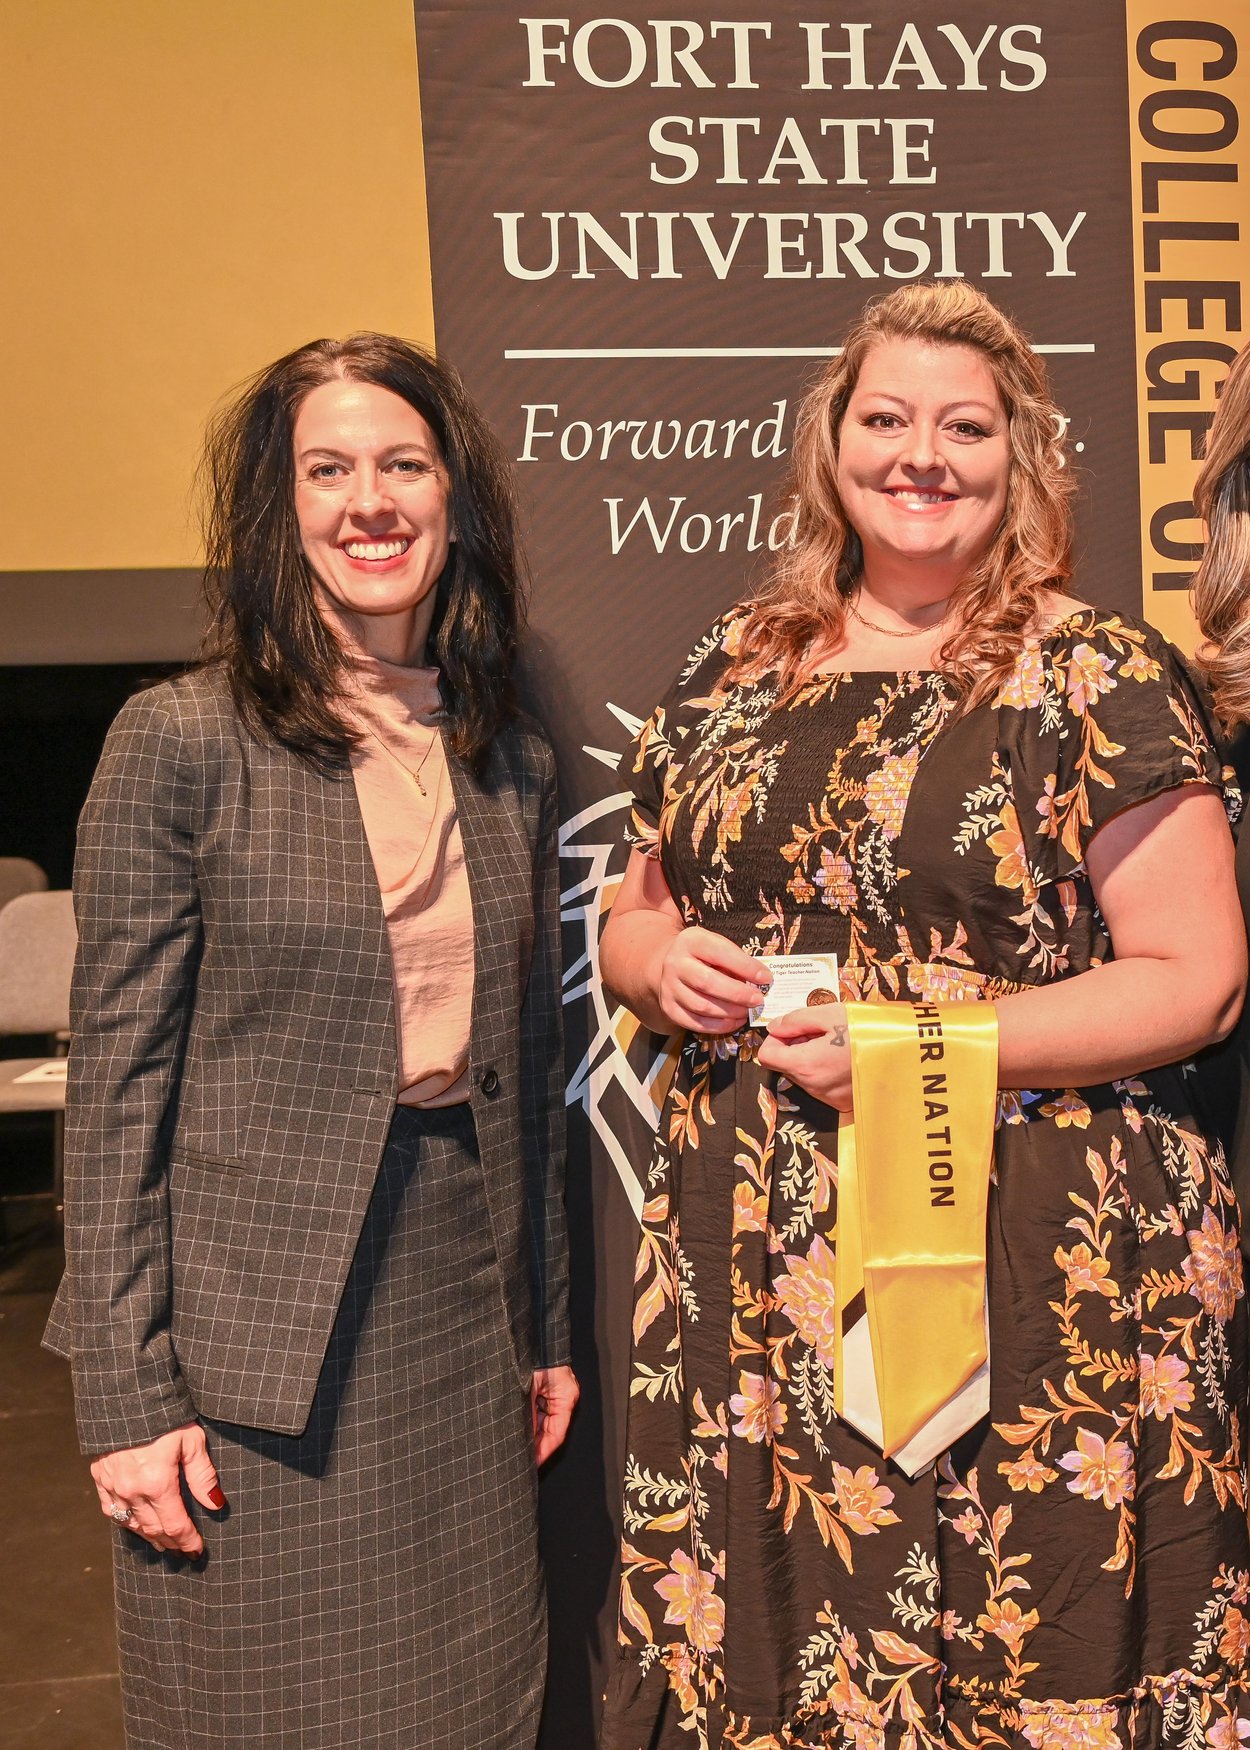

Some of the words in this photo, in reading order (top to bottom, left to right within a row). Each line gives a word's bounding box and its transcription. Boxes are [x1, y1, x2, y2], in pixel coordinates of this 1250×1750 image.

[519, 18, 772, 88] FORT
[802, 23, 1048, 92] HAYS
[648, 116, 938, 186] STATE
[493, 211, 1087, 280] UNIVERSITY
[1135, 20, 1242, 464] COLLEGE
[516, 399, 788, 462] Forward
[602, 493, 803, 555] World
[911, 1001, 944, 1063] HER
[922, 1073, 955, 1207] NATION
